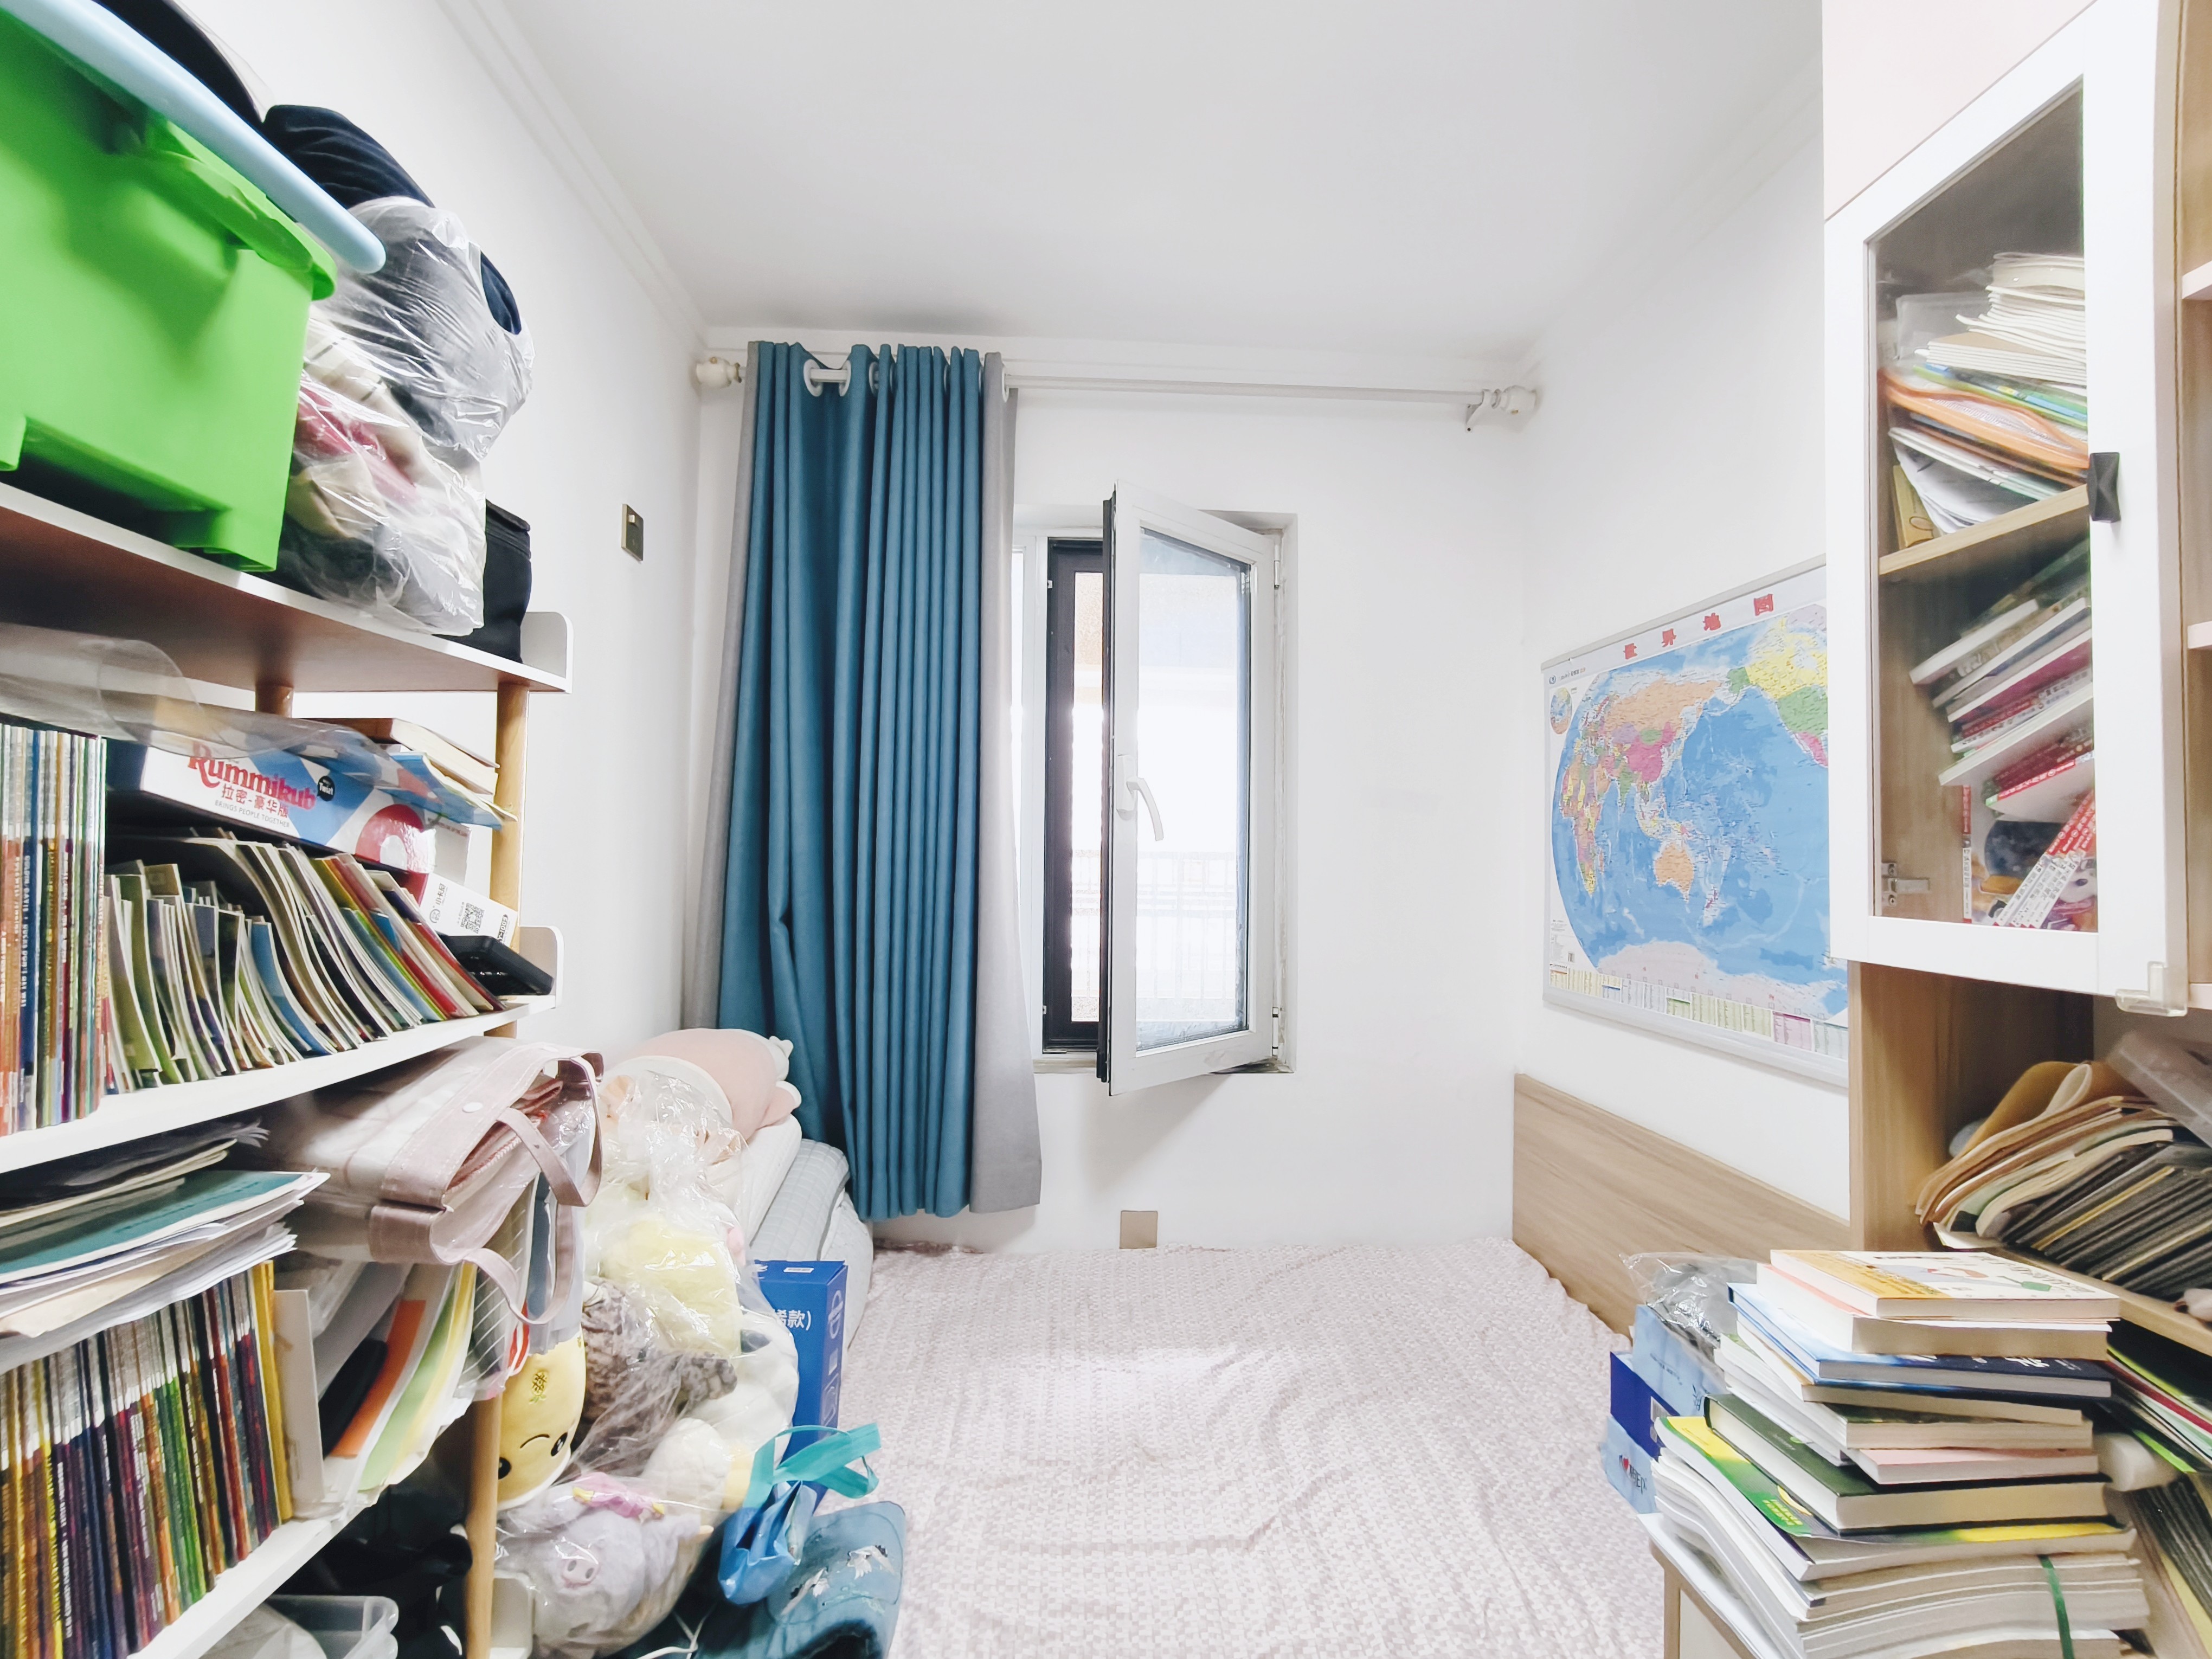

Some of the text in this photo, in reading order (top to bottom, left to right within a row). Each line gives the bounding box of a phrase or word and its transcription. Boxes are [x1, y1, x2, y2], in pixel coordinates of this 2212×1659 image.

[1623, 594, 1773, 659] 世界地图
[188, 742, 317, 811] Rummikub
[222, 783, 289, 818] 拉密-豪华版
[215, 800, 290, 828] BRINGS PEOPLE TOGETHER
